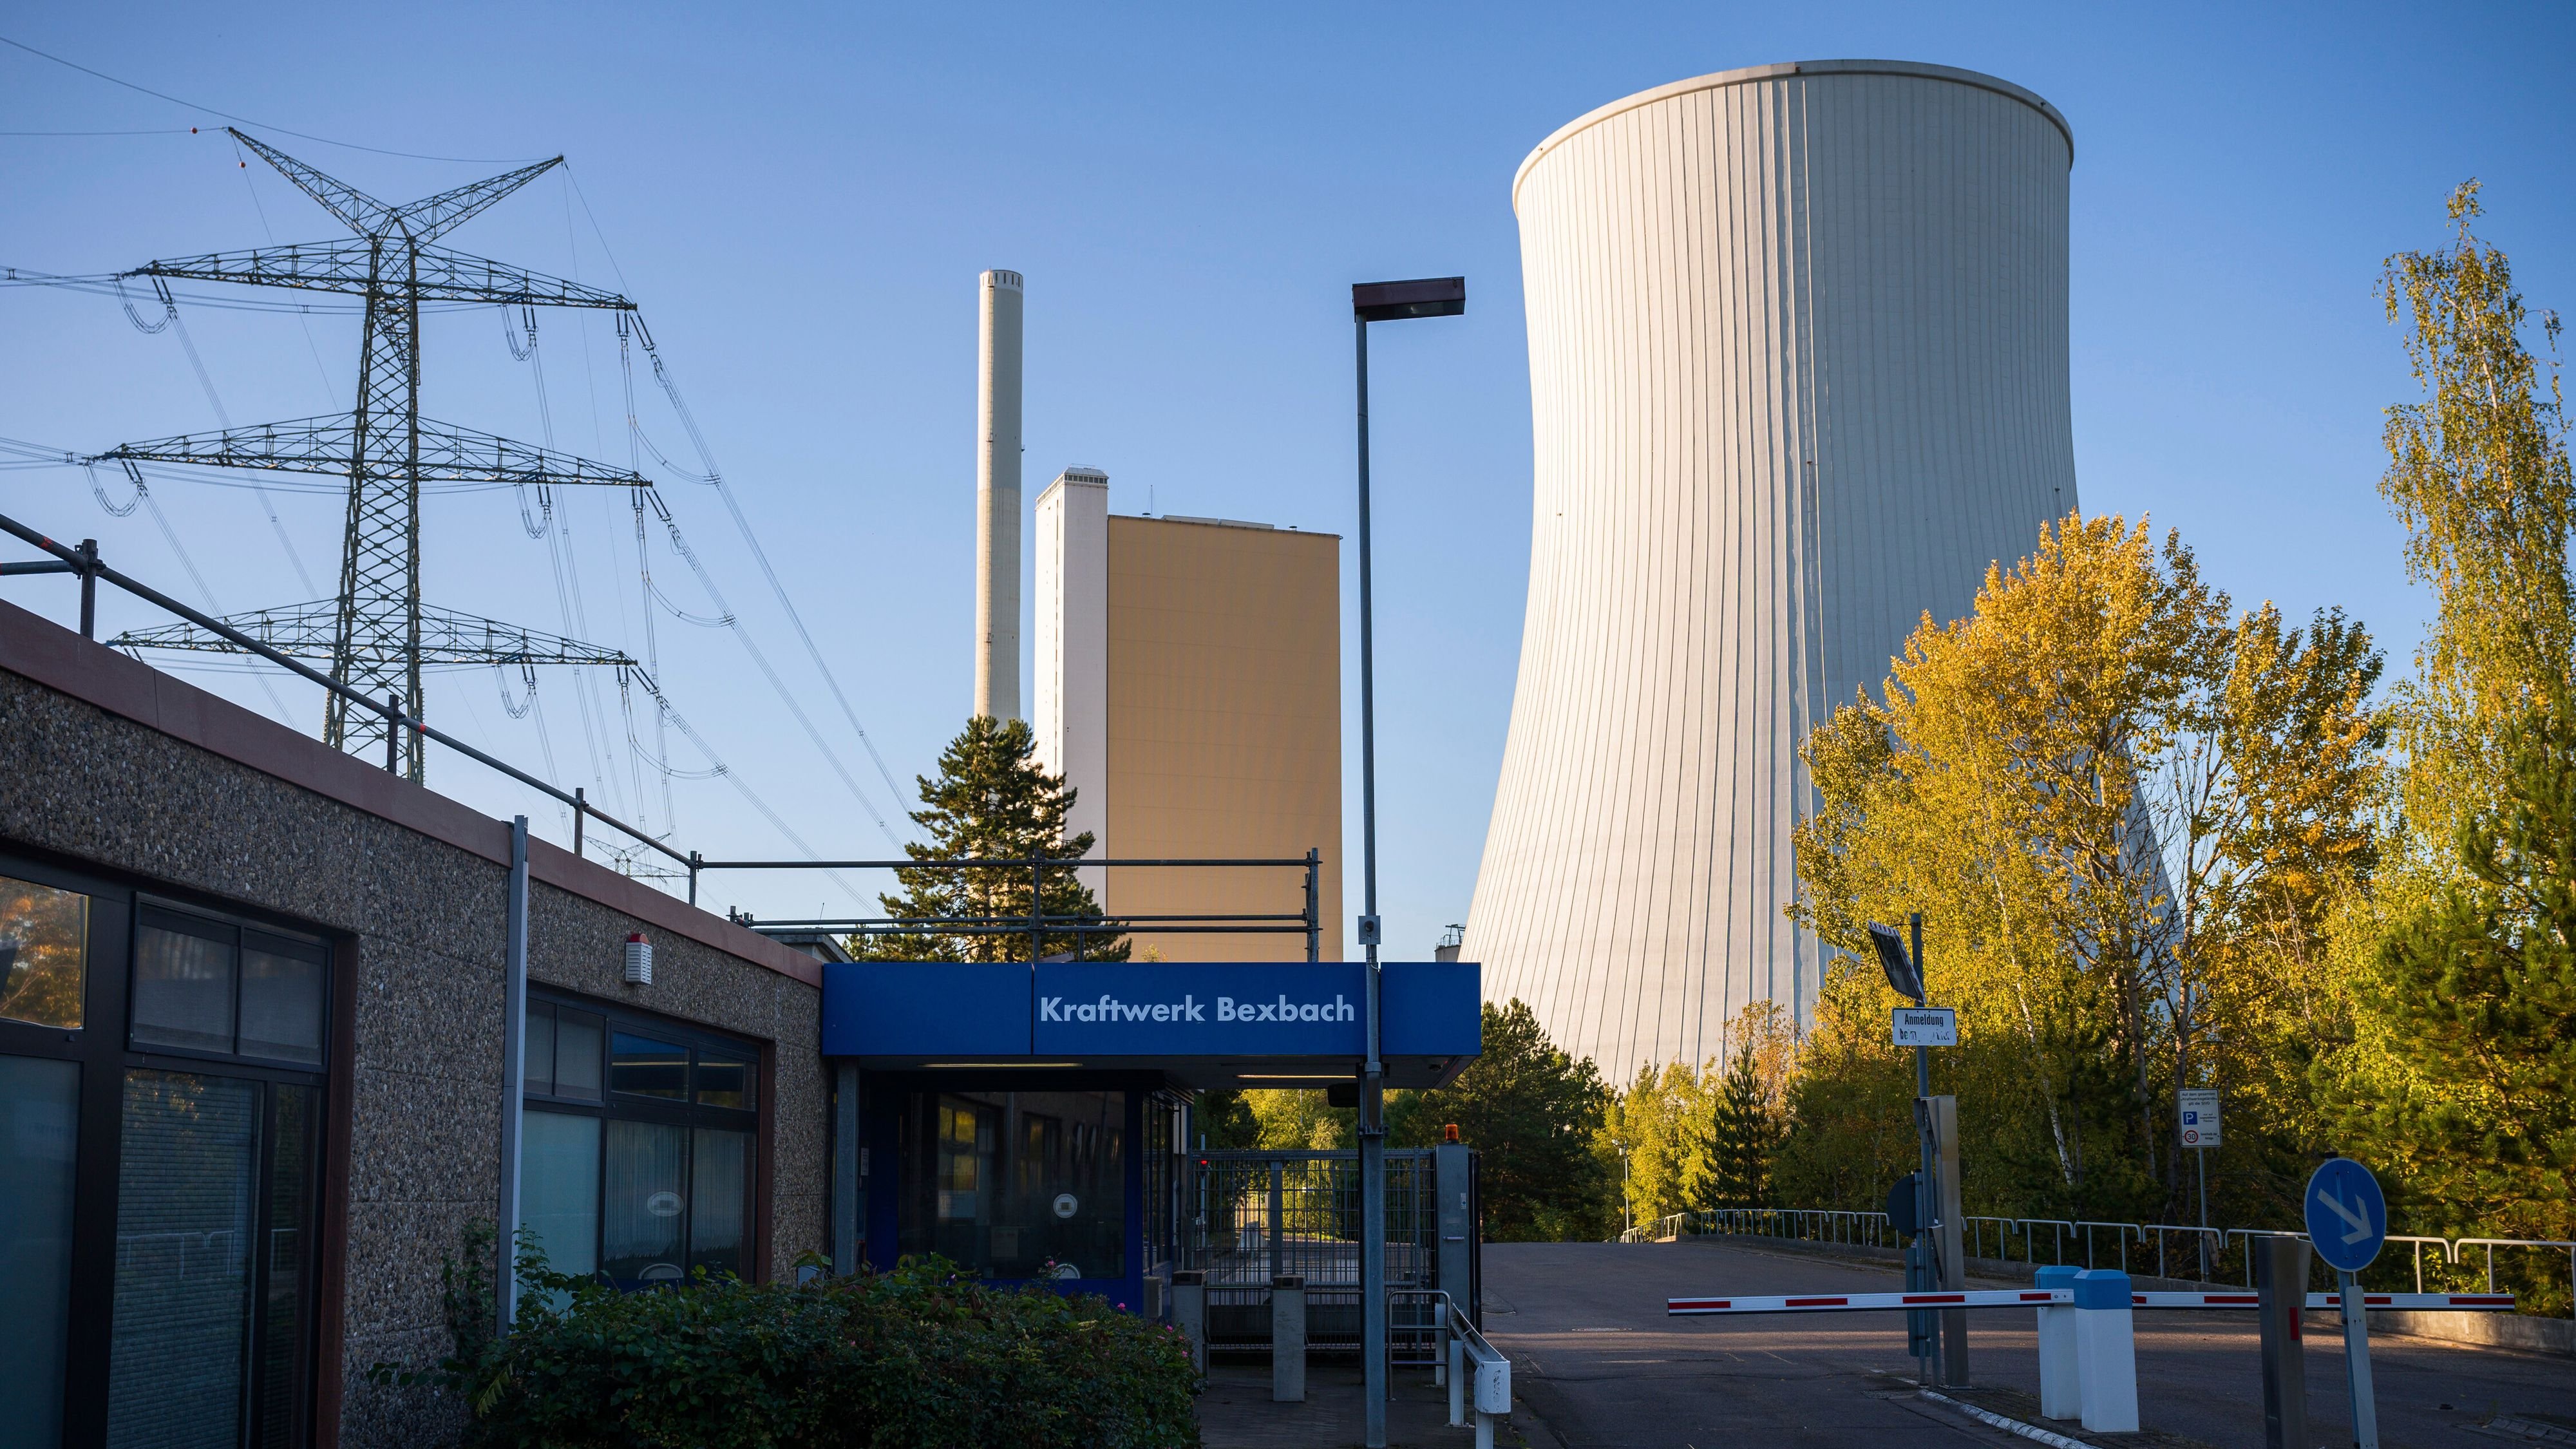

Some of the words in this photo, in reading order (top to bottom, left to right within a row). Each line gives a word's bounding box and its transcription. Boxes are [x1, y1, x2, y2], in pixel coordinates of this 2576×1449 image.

[1041, 994, 1206, 1022] Kraftwerk
[1217, 994, 1354, 1022] Bexbach
[1904, 1014, 1944, 1027] Anmeldung
[1900, 1028, 1917, 1040] bem
[2186, 1113, 2193, 1124] P
